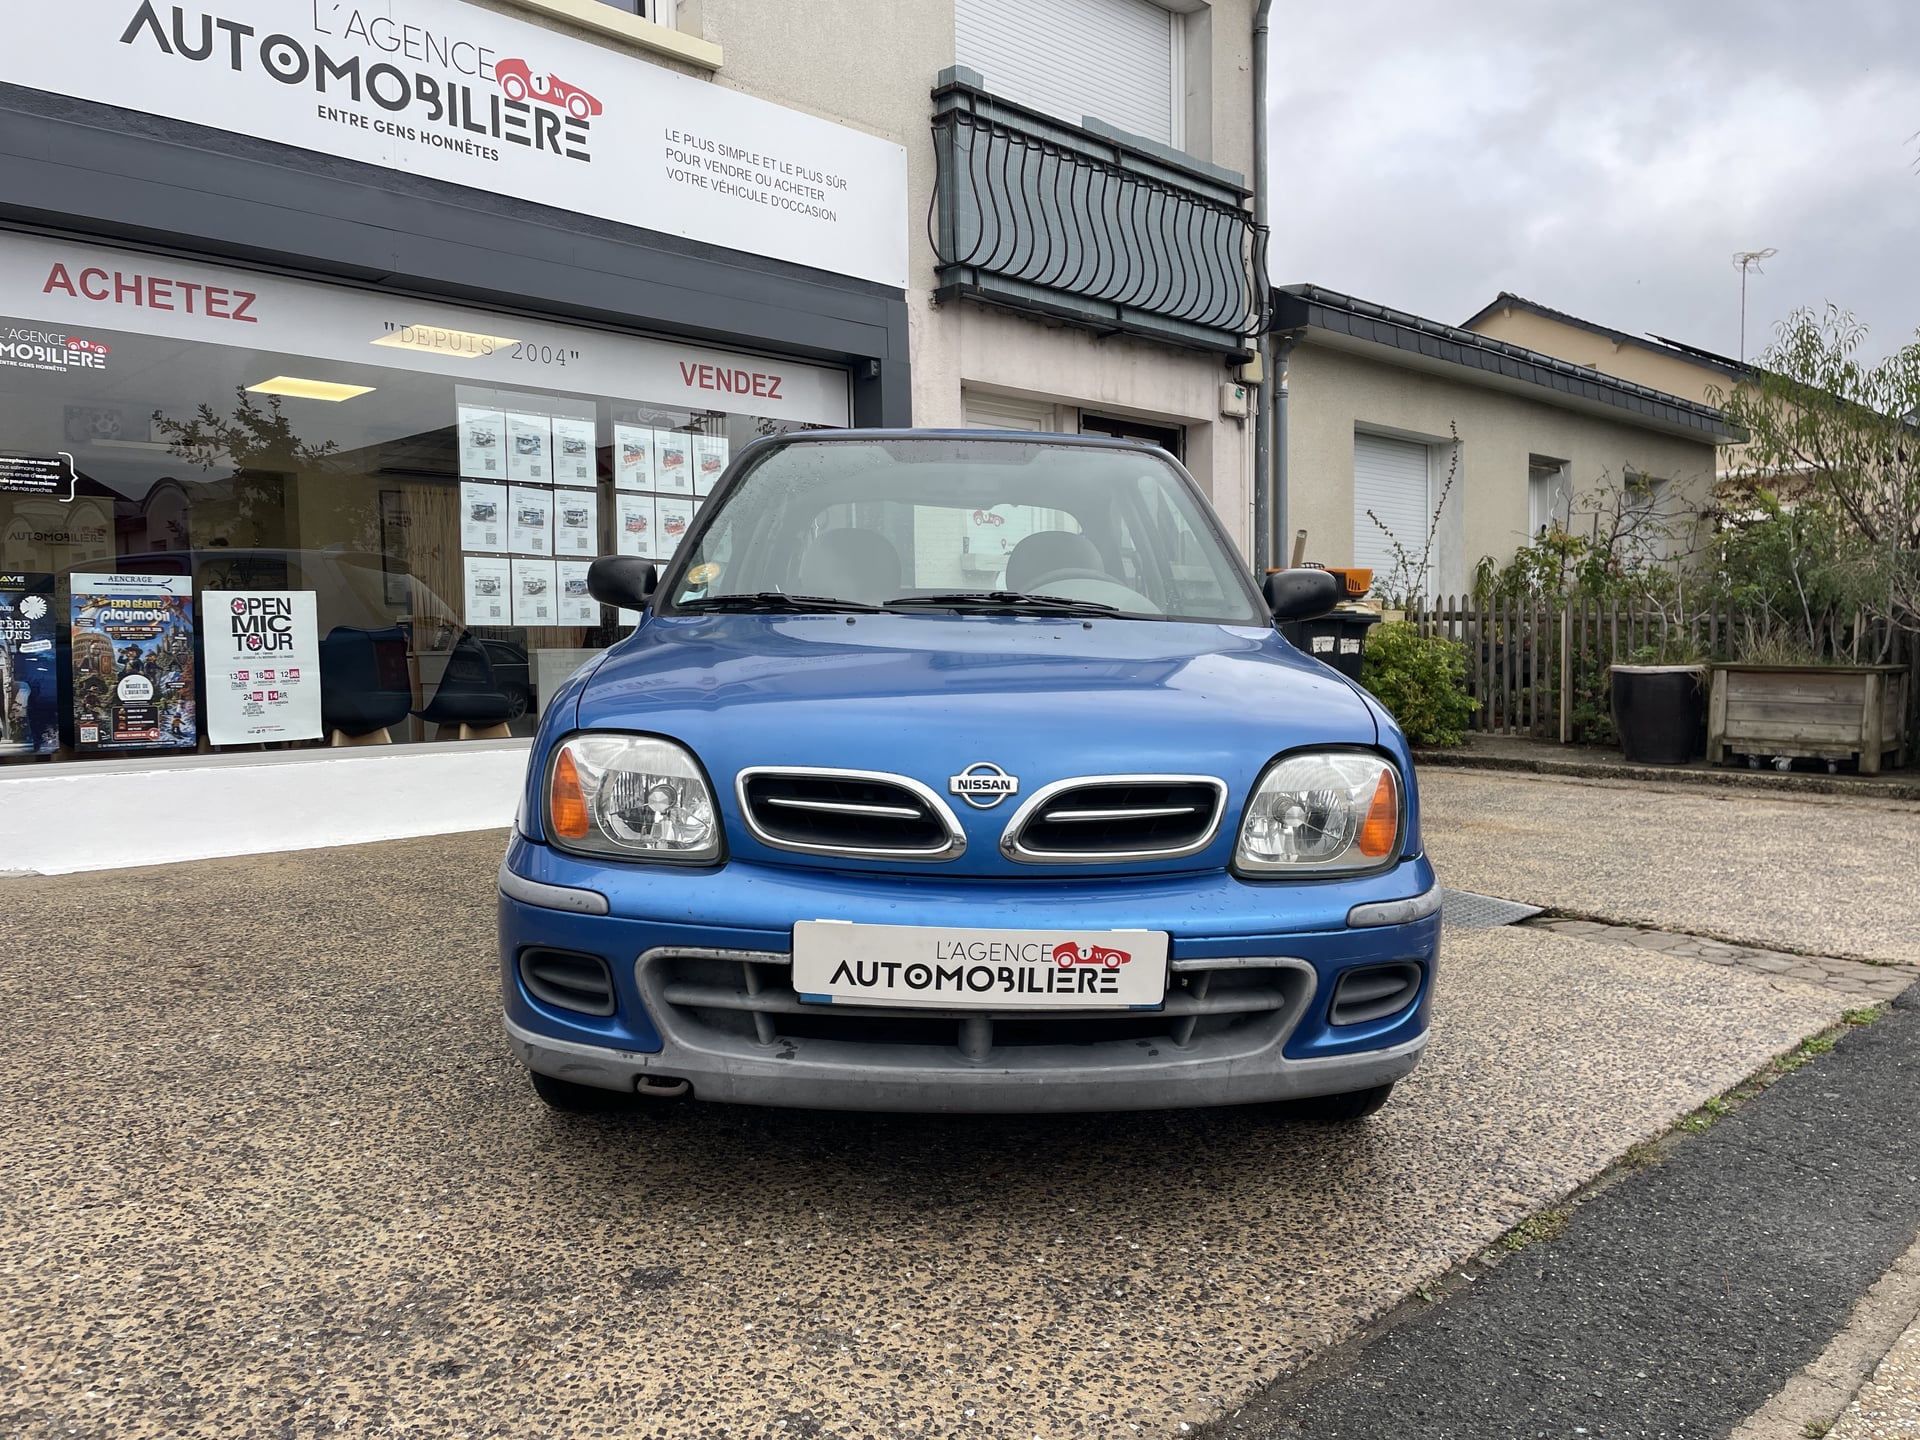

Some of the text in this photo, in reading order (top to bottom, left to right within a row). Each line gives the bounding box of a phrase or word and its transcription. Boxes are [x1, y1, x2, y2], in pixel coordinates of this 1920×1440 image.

[313, 0, 497, 82] L'AGENCE
[535, 76, 543, 91] 1
[317, 104, 499, 162] ENTRE GENS HONNÊTES
[665, 128, 847, 191] LE PLUS SIMPLE ET LE PLUS SÛR
[666, 147, 825, 202] POUR VENDRE OU ACHETER
[666, 166, 837, 222] VOTRE VÉHICULE D'OCCASION
[42, 262, 258, 323] ACHETEZ
[384, 321, 580, 367] "DEPUIS 2004"
[679, 361, 783, 400] VENDEZ
[108, 575, 152, 583] AENCRAGE
[111, 598, 162, 608] EXPO GÉANTE
[230, 597, 291, 615] OPEN
[100, 608, 170, 624] playmobil
[231, 615, 292, 633] MIC
[232, 633, 293, 651] TOUR
[957, 779, 1011, 790] NISSAN
[936, 940, 1054, 963] L'AGENCE
[1082, 949, 1088, 958] 1
[829, 959, 1121, 994] AUTOMOBILIERE
